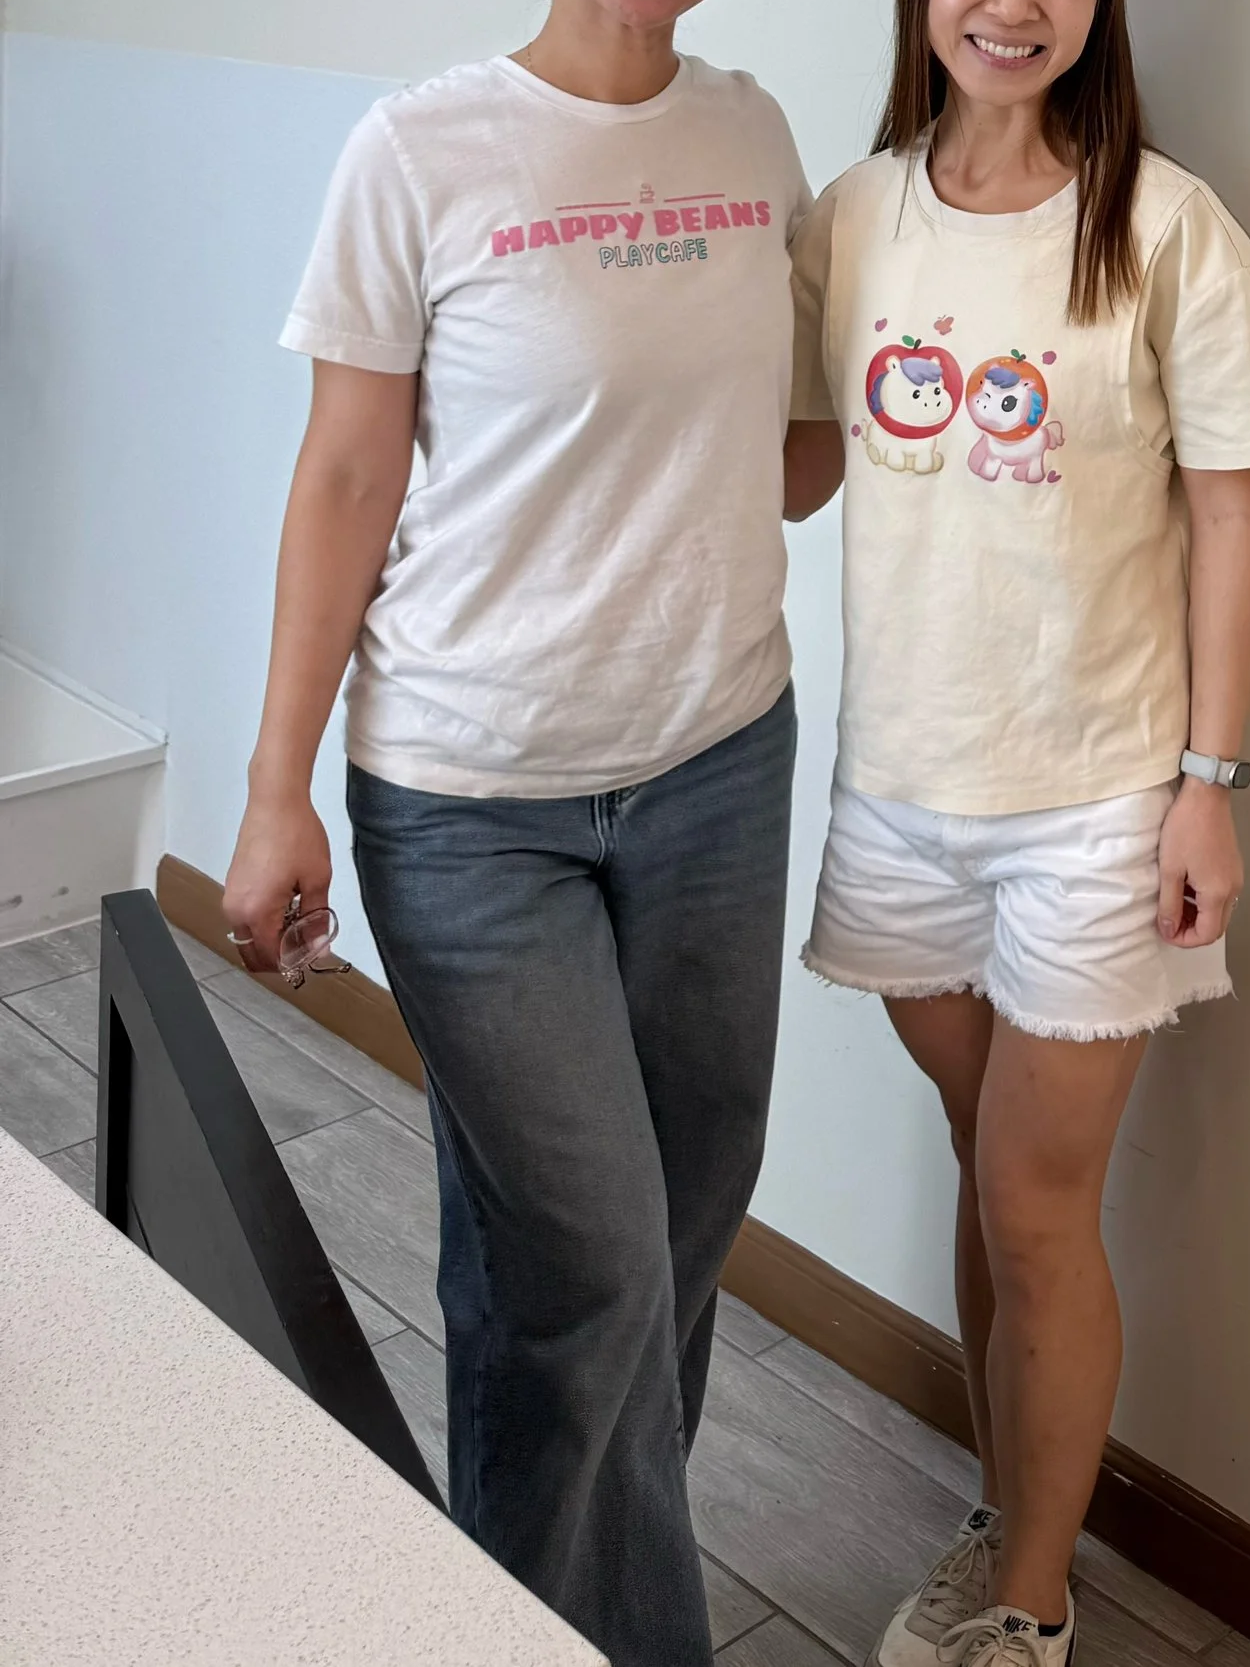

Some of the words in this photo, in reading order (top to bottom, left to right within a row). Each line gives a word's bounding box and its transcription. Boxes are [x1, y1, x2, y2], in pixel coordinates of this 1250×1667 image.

[491, 212, 644, 256] HAPPY
[653, 201, 771, 236] BEANS
[600, 238, 708, 269] PLAYCAFE
[1002, 1614, 1033, 1633] NIKE
